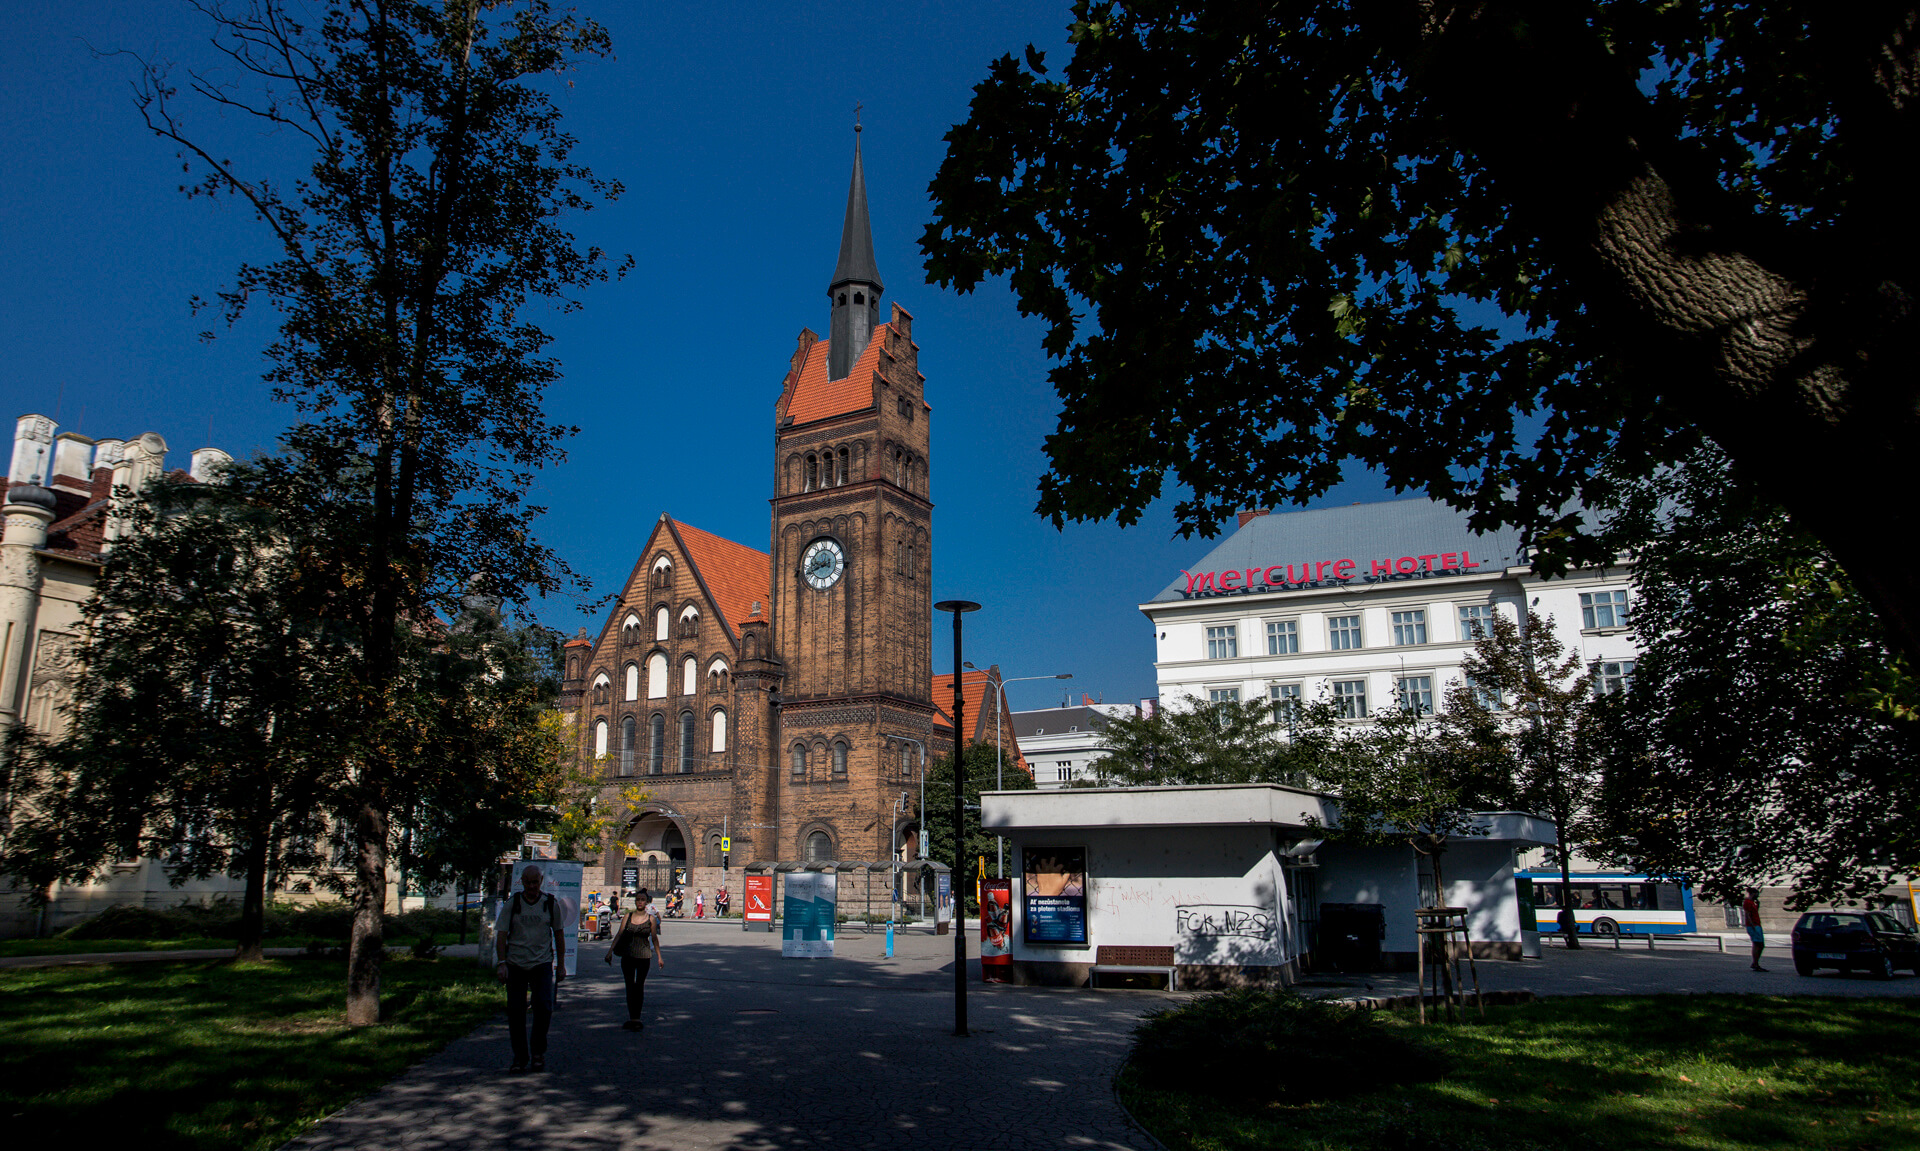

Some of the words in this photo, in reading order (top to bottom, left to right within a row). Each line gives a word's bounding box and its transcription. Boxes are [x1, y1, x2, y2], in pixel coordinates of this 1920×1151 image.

[1371, 551, 1479, 577] HOTEL
[1177, 910, 1218, 934] FCK
[1224, 910, 1268, 934] NZS
